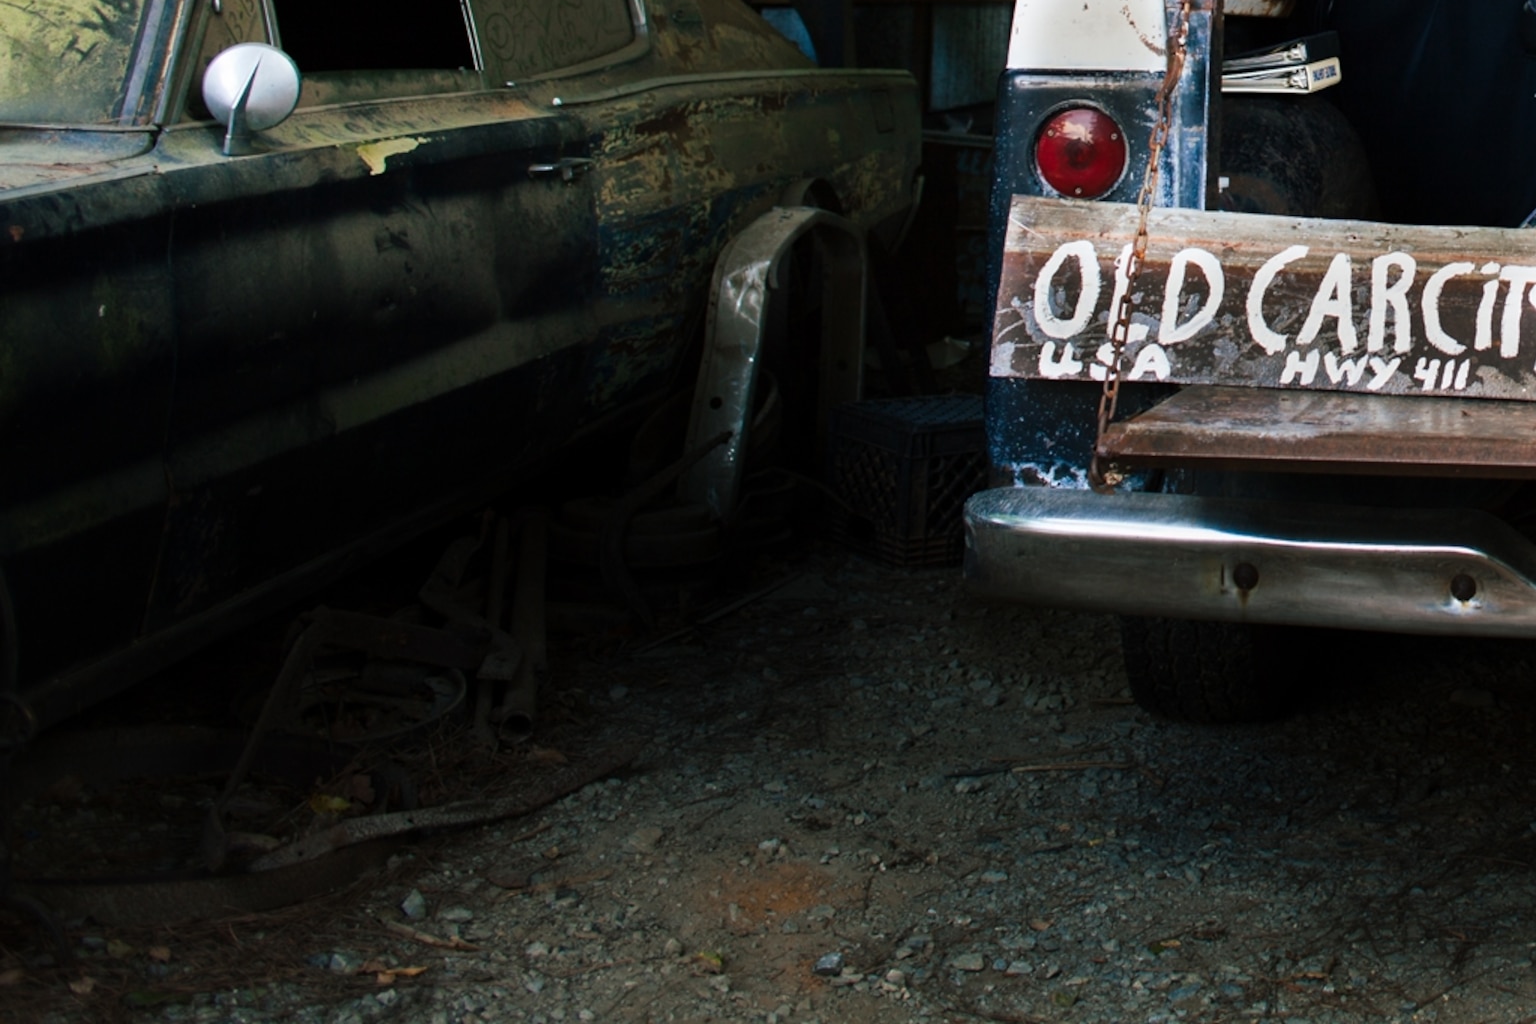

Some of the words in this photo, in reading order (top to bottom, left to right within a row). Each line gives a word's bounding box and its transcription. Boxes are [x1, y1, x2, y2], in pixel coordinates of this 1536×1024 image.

[1033, 239, 1223, 344] OLD
[1038, 340, 1171, 380] USA
[1279, 349, 1401, 391] HWY
[1415, 353, 1471, 391] 411
